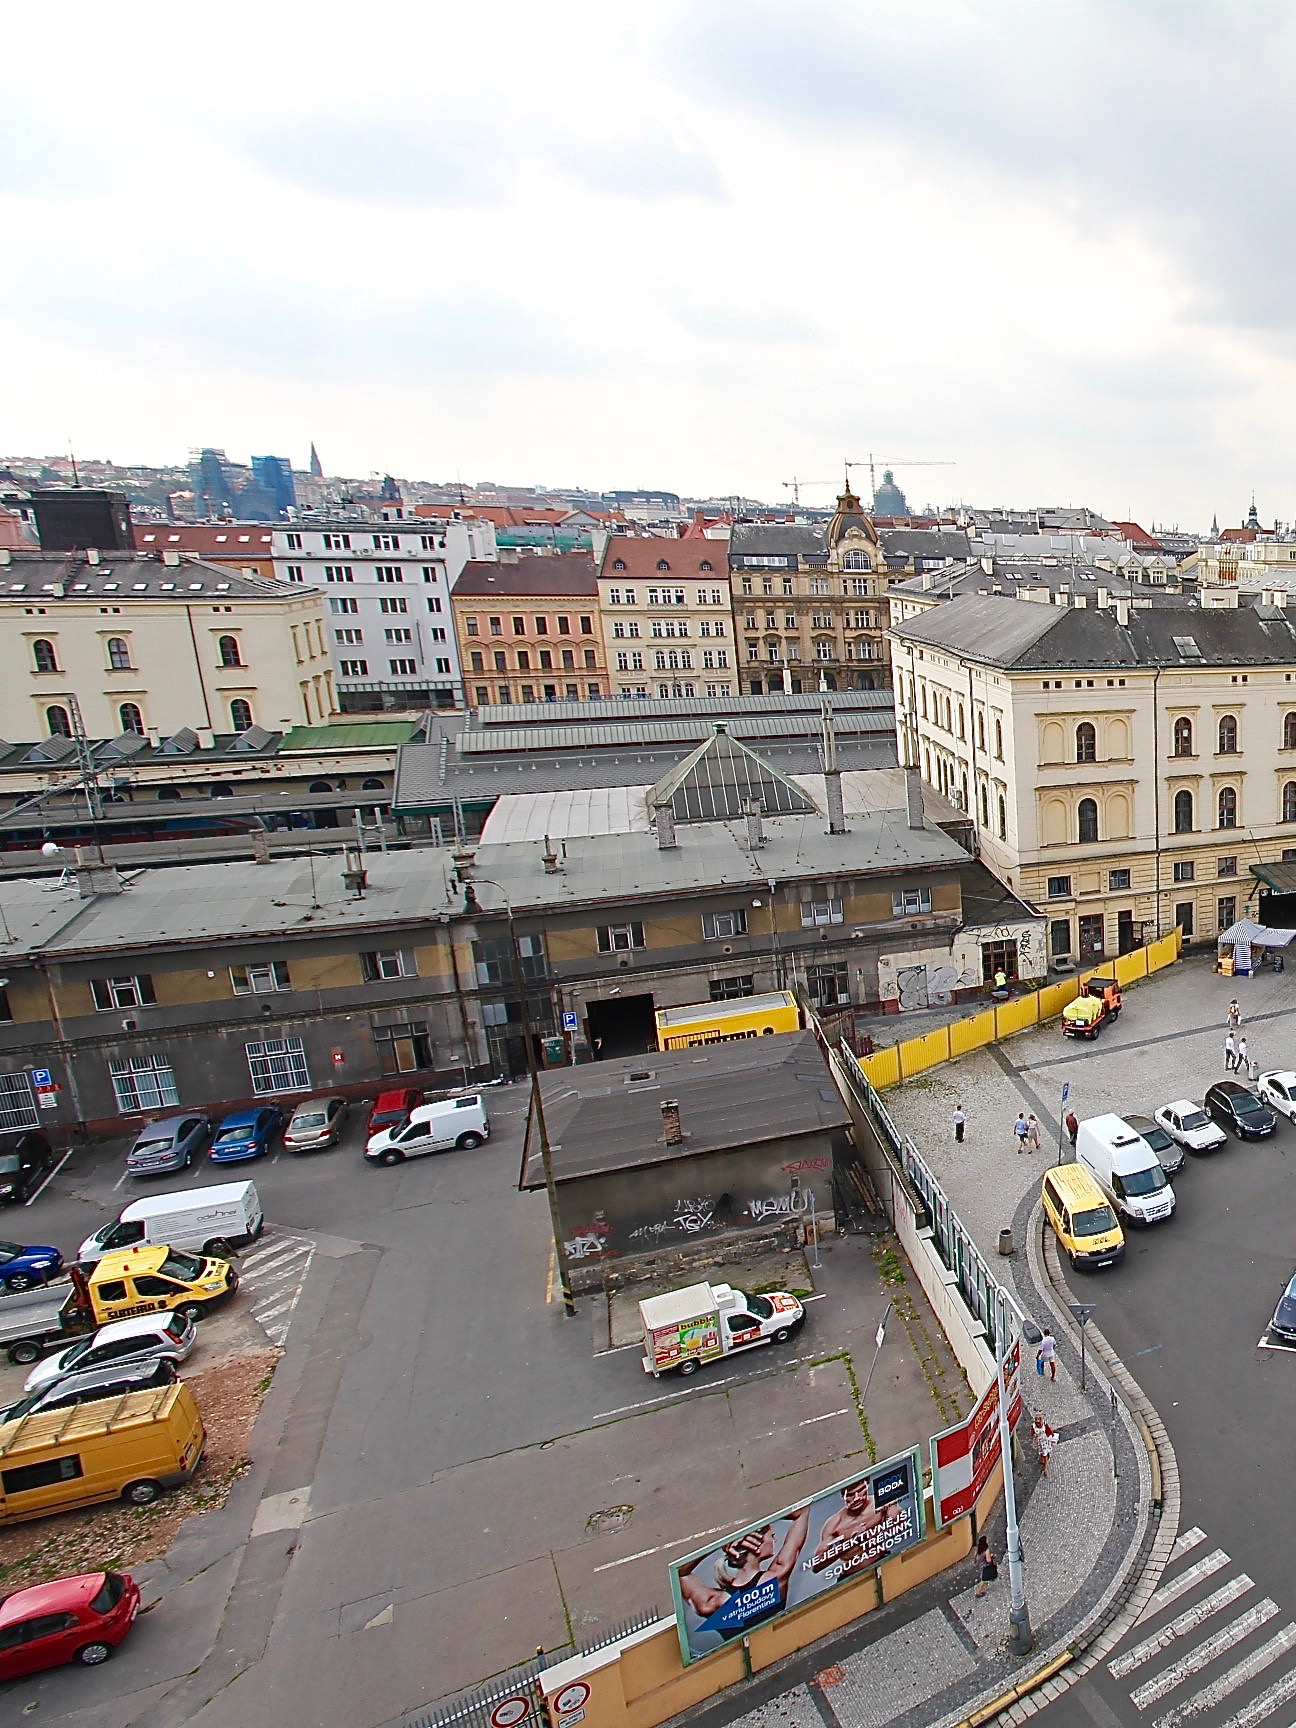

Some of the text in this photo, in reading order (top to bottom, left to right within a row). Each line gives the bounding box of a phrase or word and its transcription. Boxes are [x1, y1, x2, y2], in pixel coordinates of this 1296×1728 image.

[36, 1071, 46, 1081] P
[680, 1315, 716, 1331] bubble
[803, 1506, 912, 1571] NEJEFEKTIVNĚJŠÍ
[824, 1530, 914, 1580] SOUČASNOSTI
[728, 1606, 746, 1619] atriu
[746, 1591, 775, 1610] budovy
[735, 1583, 775, 1607] 100 m
[737, 1597, 776, 1620] Florentina
